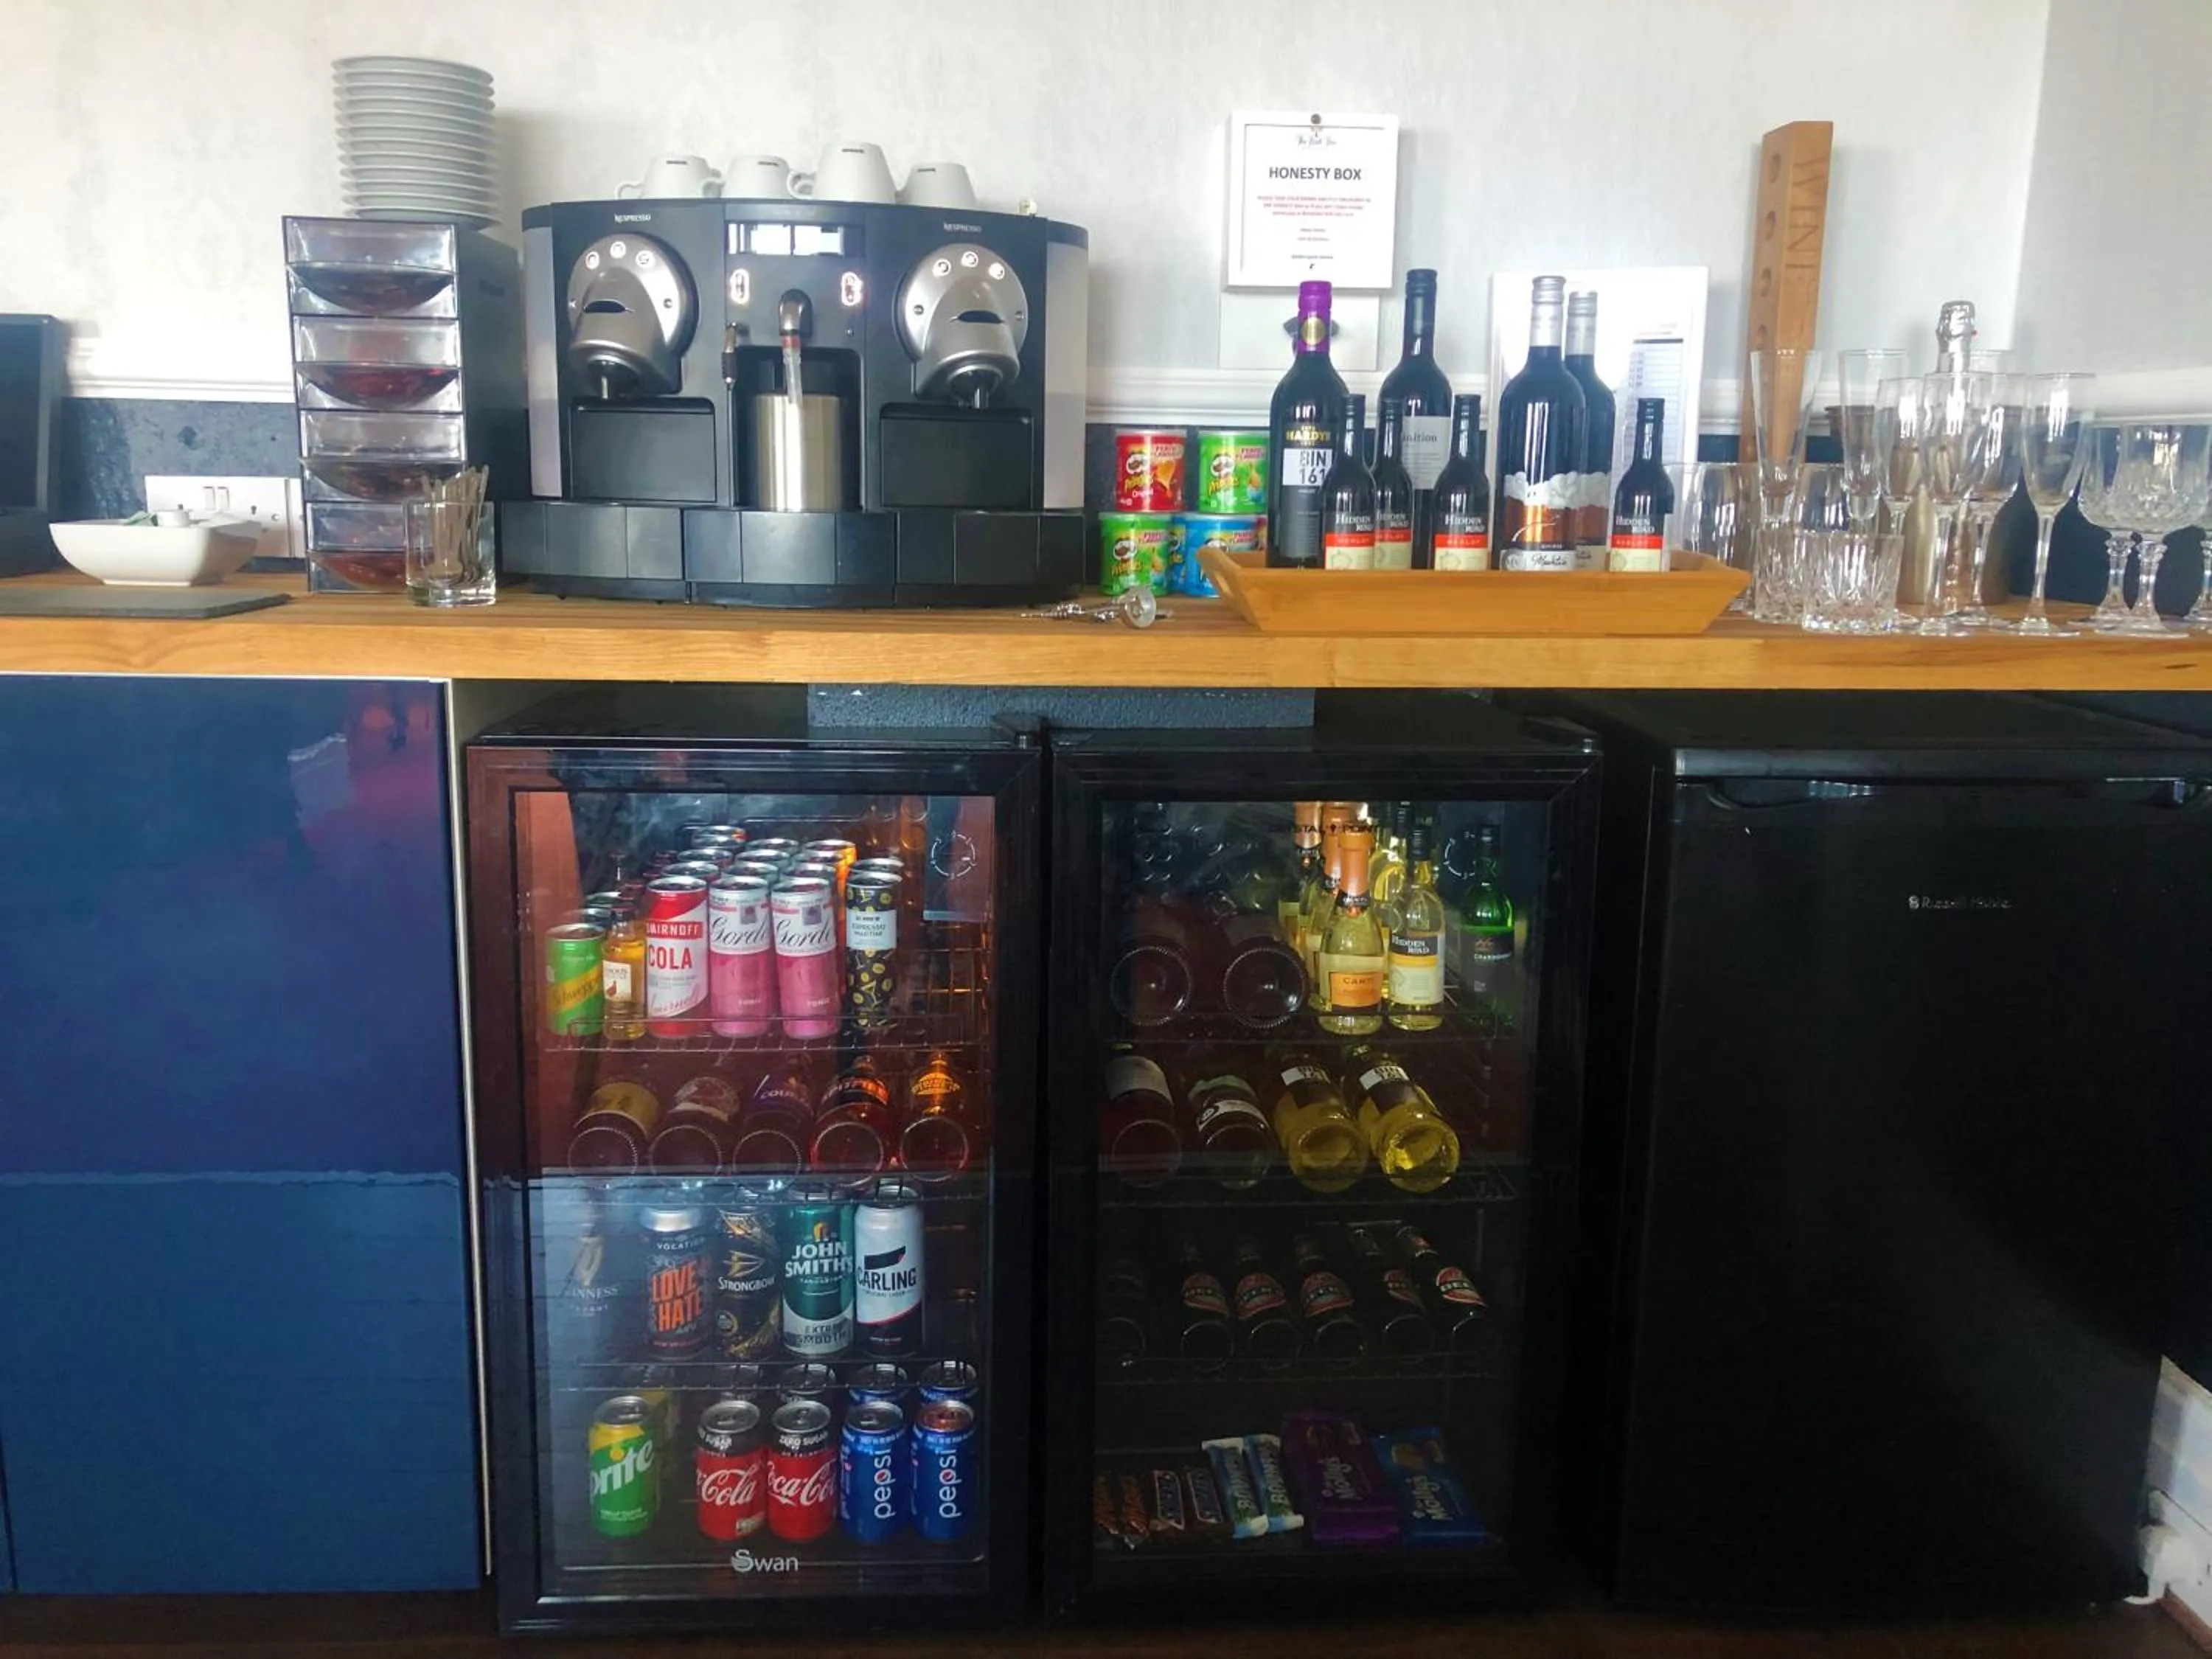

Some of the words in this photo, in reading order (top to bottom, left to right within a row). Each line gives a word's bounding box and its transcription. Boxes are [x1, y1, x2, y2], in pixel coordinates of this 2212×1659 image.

[1268, 166, 1331, 180] HONESTY
[1333, 167, 1363, 181] BOX
[1299, 451, 1327, 467] BIN
[1298, 468, 1326, 484] 161
[648, 945, 692, 970] COLA
[791, 1242, 848, 1259] JOHN
[651, 1260, 697, 1303] LOVE
[856, 1266, 917, 1291] CARLING
[589, 1439, 655, 1504] prite
[874, 1448, 897, 1519] pepsi
[939, 1449, 963, 1519] pepsi
[731, 1549, 799, 1573] Swan
